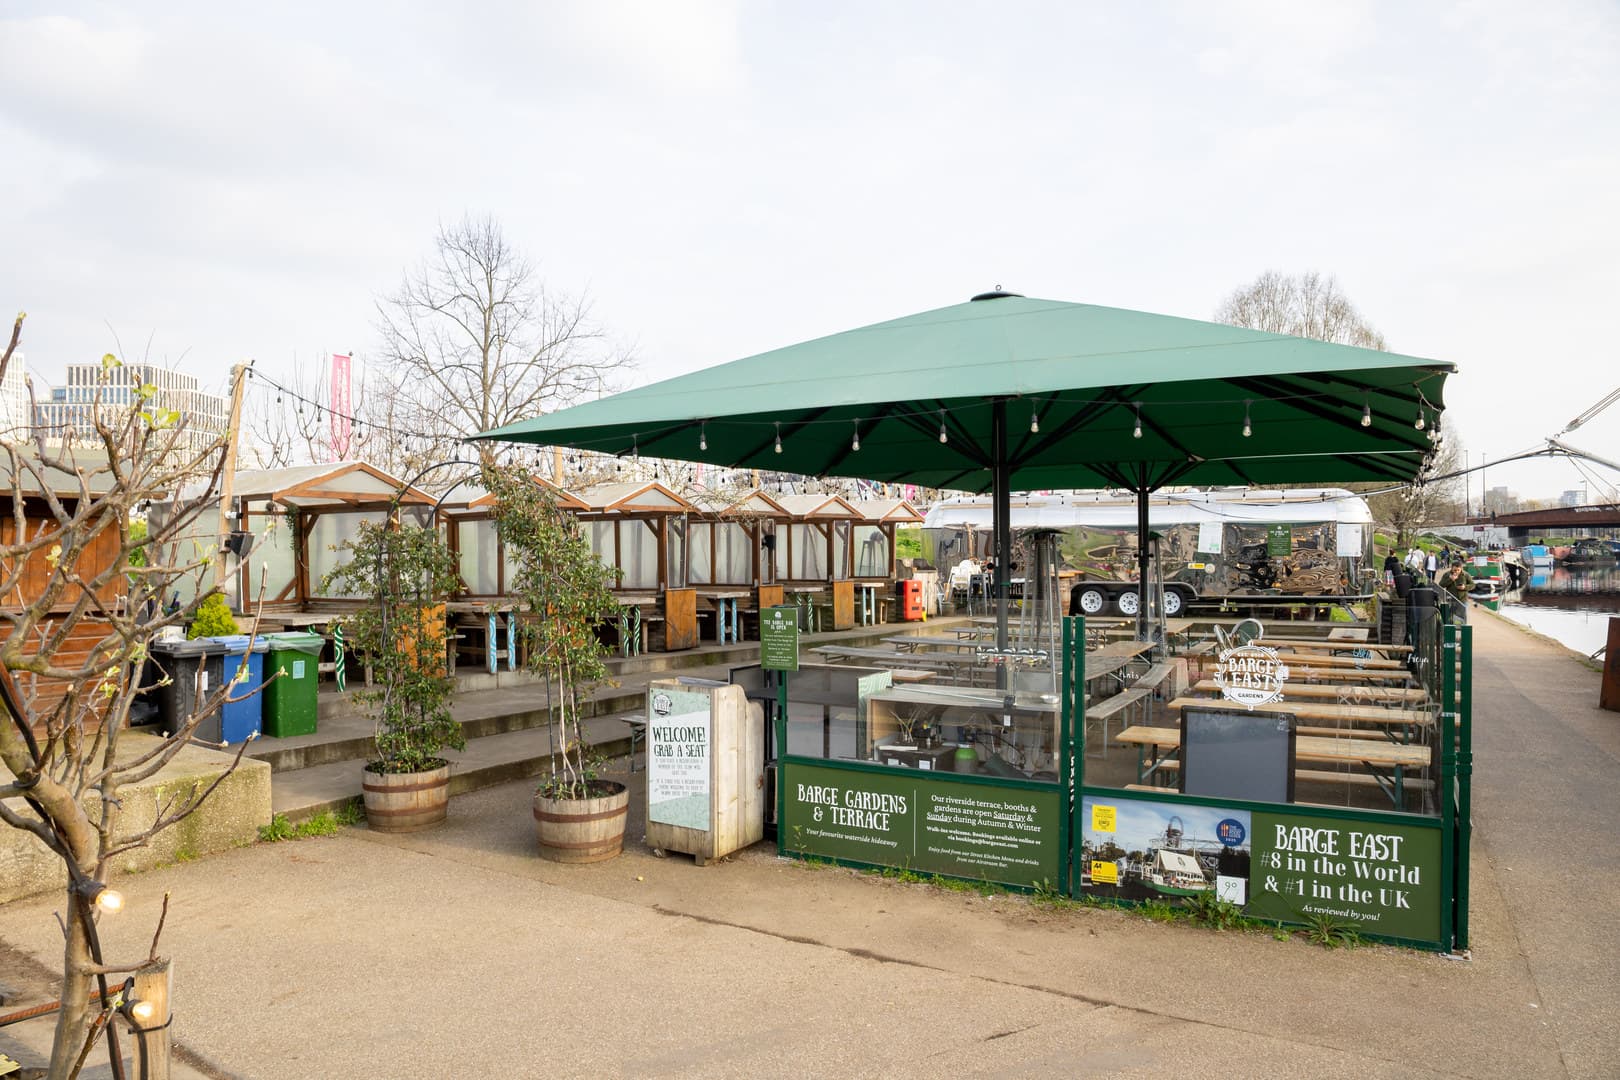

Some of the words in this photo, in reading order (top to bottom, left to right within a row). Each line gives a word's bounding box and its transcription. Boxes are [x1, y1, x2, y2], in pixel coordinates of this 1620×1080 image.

[1228, 657, 1275, 675] BARGE
[1231, 672, 1272, 690] EAST
[652, 726, 706, 743] WELCOME!
[654, 744, 674, 757] GRAB
[677, 744, 683, 757] A
[686, 745, 705, 758] SEAT
[797, 784, 838, 806] BARGE
[845, 790, 907, 814] GARDENS
[931, 795, 944, 803] Our
[946, 796, 976, 806] riverside
[976, 800, 1003, 810] terrace,
[1004, 802, 1028, 813] booths
[1030, 805, 1037, 813] &
[813, 806, 823, 821] &
[830, 806, 890, 831] TERRACE
[926, 812, 952, 822] Sunday
[953, 814, 976, 826] during
[977, 818, 1006, 828] Autumn
[1016, 823, 1041, 832] Winter
[934, 805, 961, 814] gardens
[974, 810, 992, 818] open
[993, 811, 1026, 822] Saturday
[1274, 824, 1340, 856] BARGE
[1348, 831, 1403, 862] EAST
[1260, 850, 1281, 869] #8
[1287, 853, 1307, 872] in
[1313, 856, 1346, 876] the
[1353, 860, 1420, 885] World
[1264, 875, 1279, 893] &
[1285, 878, 1304, 896] #1
[1312, 879, 1332, 900] in
[1339, 883, 1372, 904] the
[1380, 888, 1410, 909] UK
[1302, 904, 1312, 912] As
[1313, 906, 1349, 917] reviewed
[1350, 908, 1360, 918] by
[1360, 910, 1381, 921] you!
